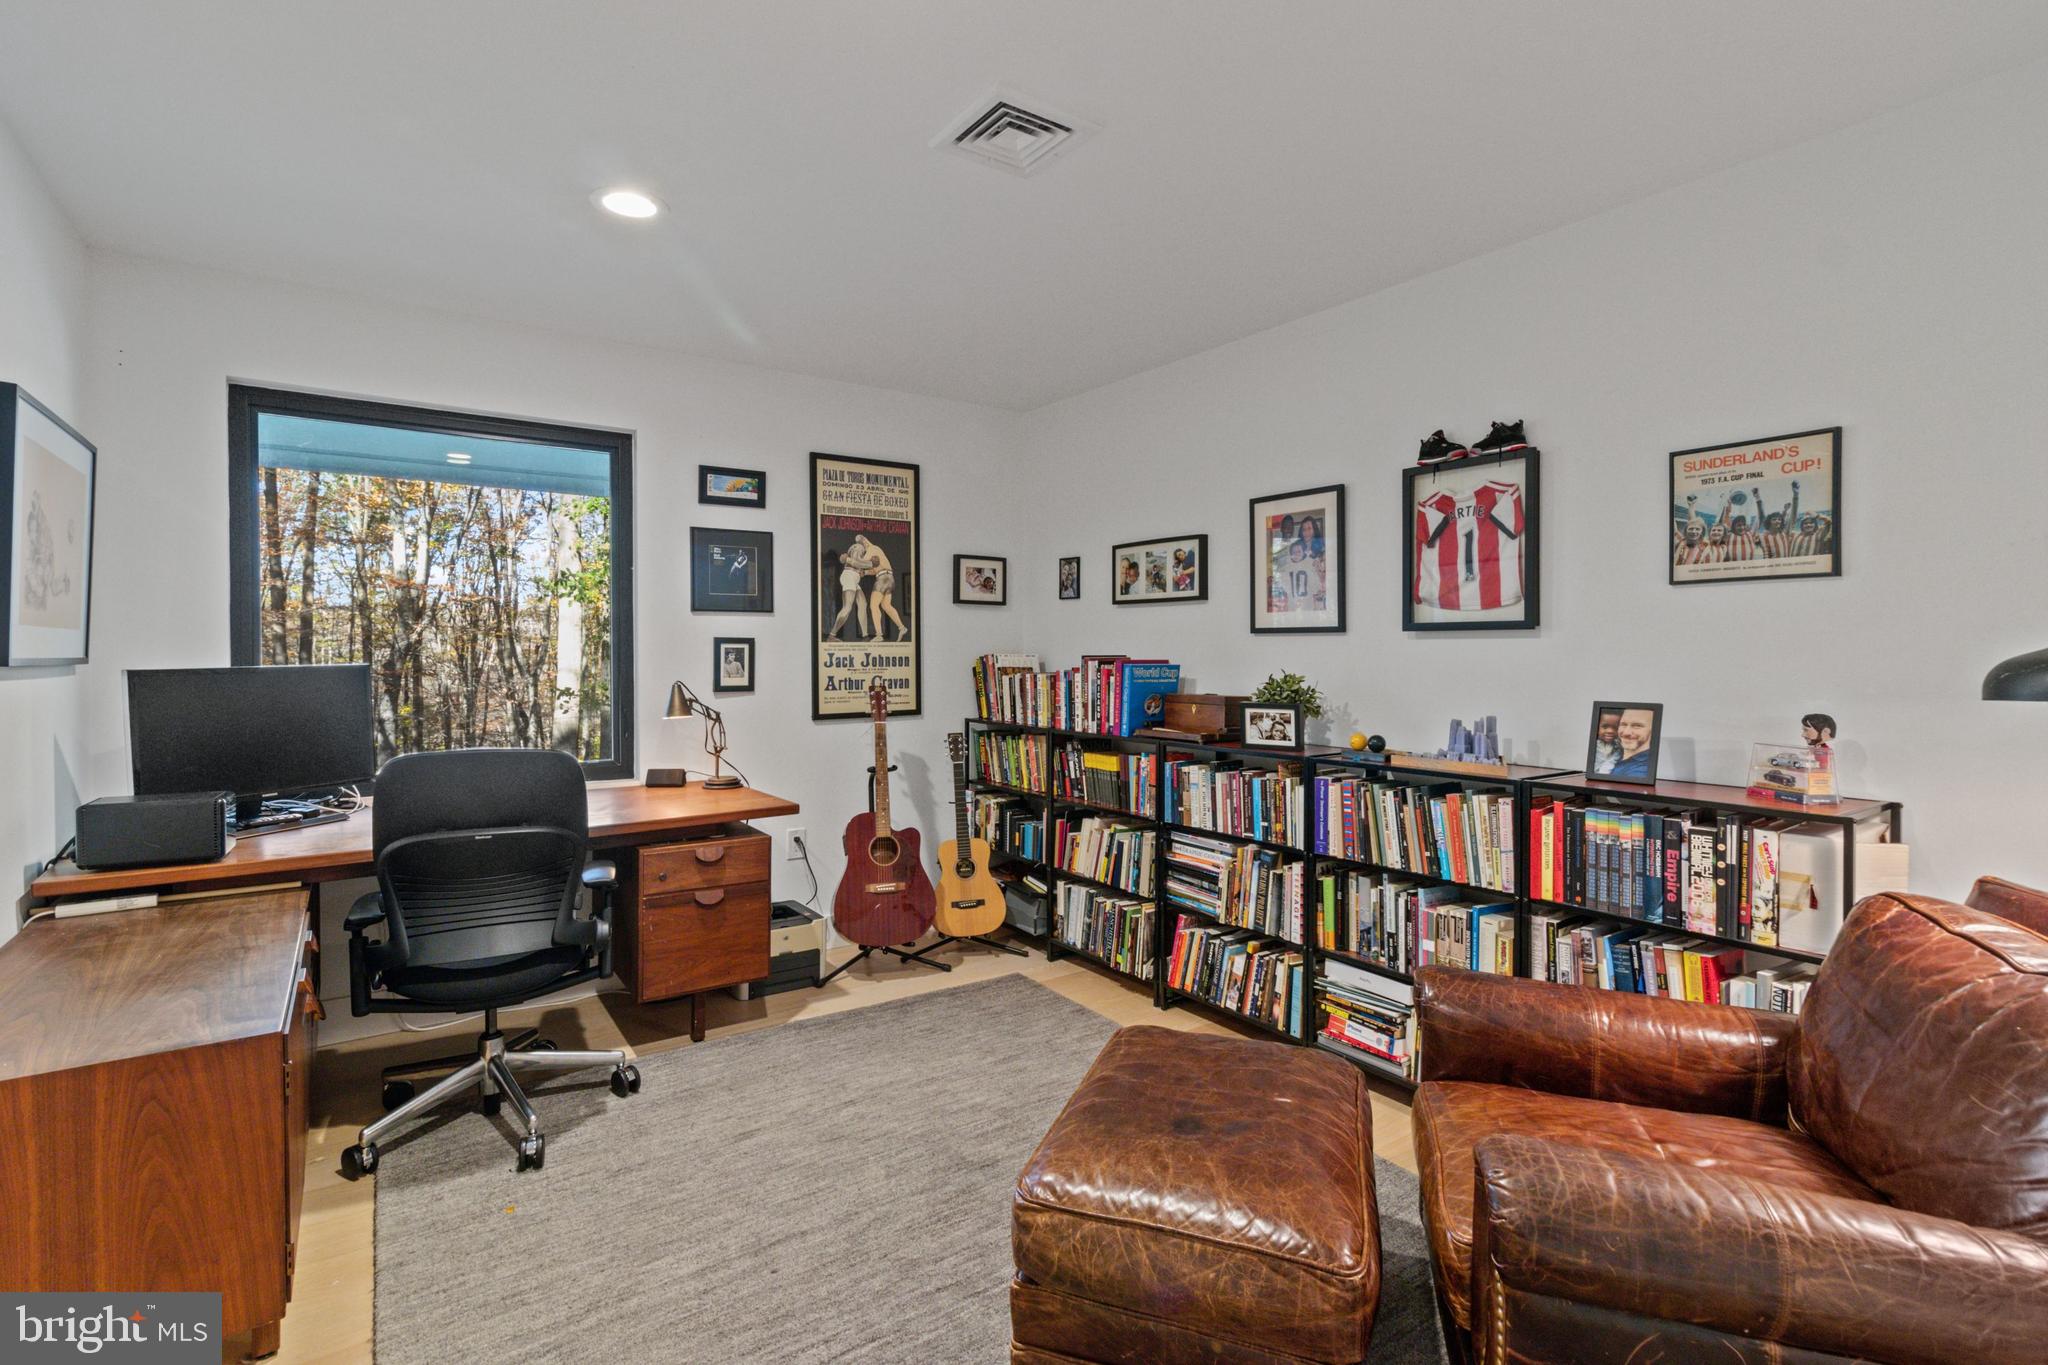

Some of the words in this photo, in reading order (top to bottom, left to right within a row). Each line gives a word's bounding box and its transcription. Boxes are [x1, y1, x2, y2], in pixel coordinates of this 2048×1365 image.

[1683, 445, 1800, 473] SUNDERLAND'S
[1780, 458, 1822, 474] CUP!
[866, 473, 910, 489] MONUMENTAL
[1700, 477, 1716, 486] 1973
[1730, 473, 1744, 482] CUP
[1746, 471, 1765, 480] FINAL
[823, 490, 844, 502] GRAN
[846, 492, 872, 505] FIESTA
[873, 494, 883, 506] DE
[884, 496, 909, 508] BOXEO
[823, 652, 855, 668] Jack
[860, 652, 910, 668] Johnson
[823, 675, 866, 691] Arthur
[1664, 849, 1680, 903] Empire
